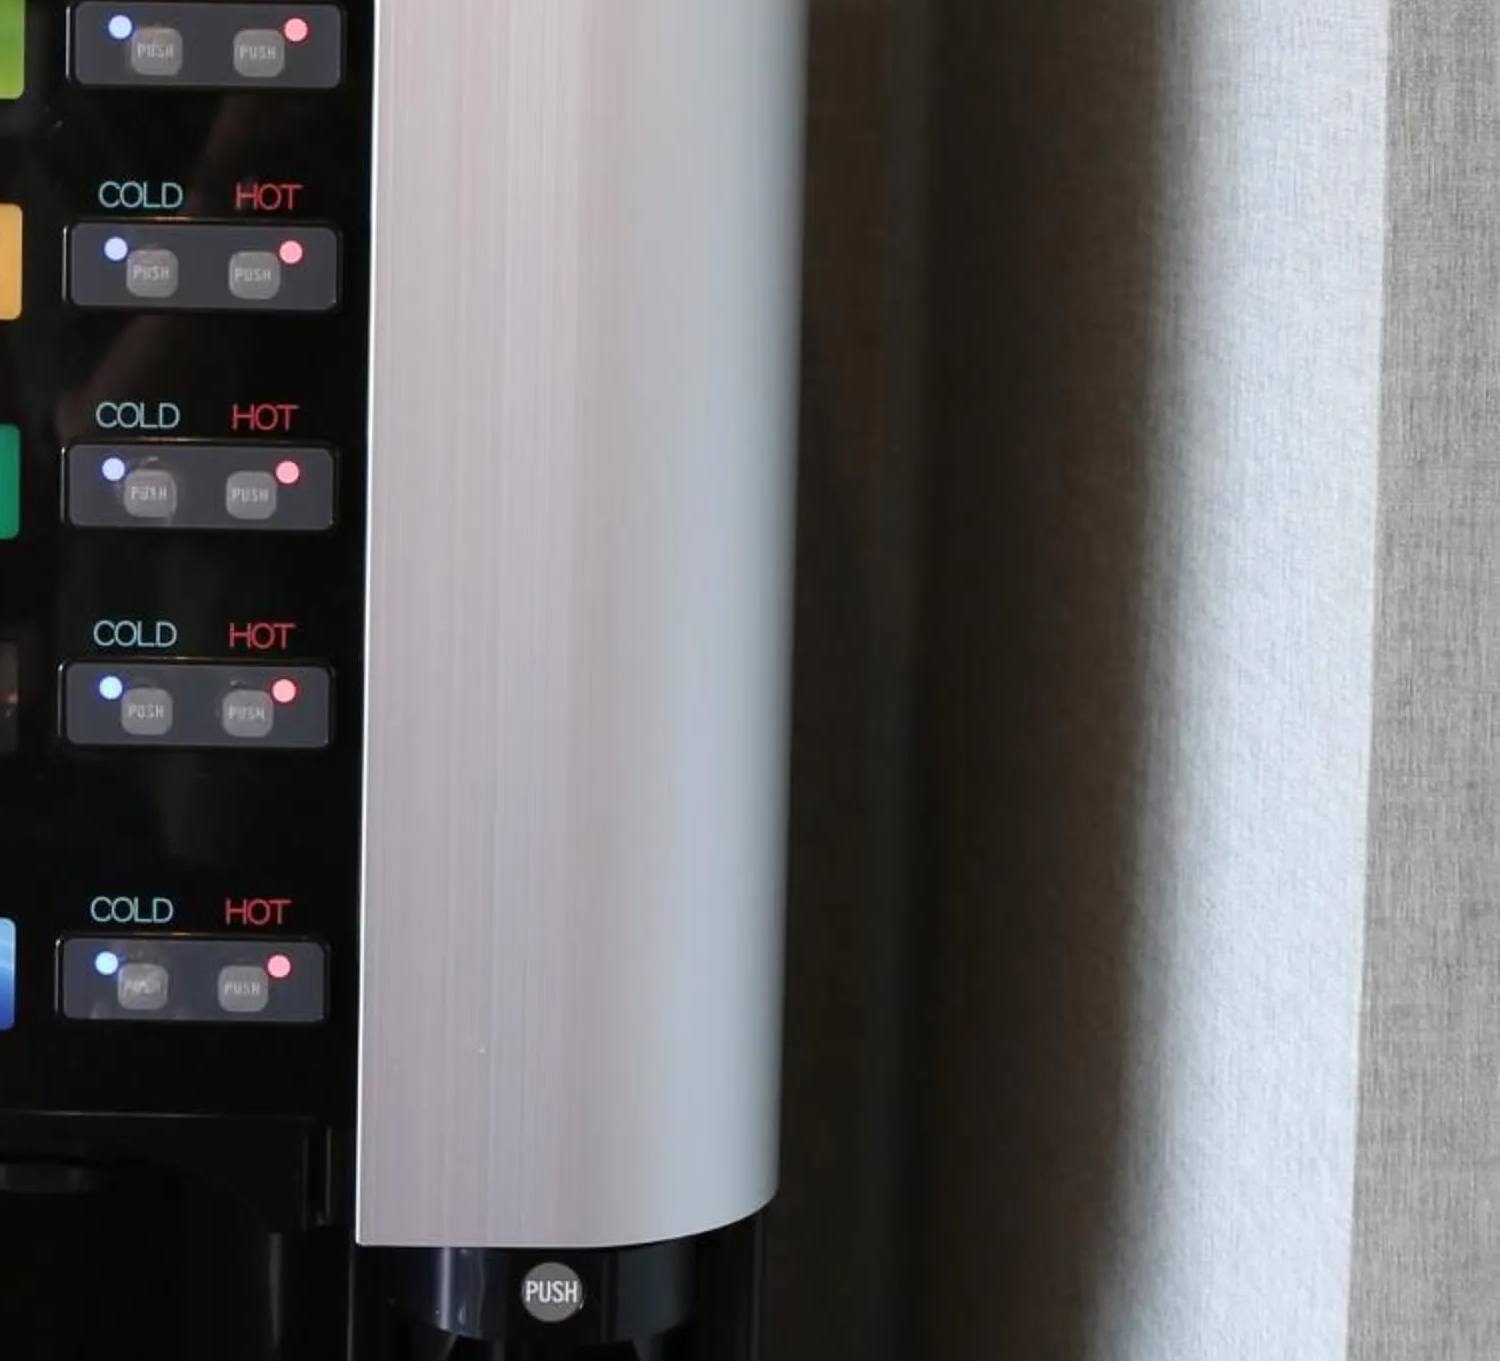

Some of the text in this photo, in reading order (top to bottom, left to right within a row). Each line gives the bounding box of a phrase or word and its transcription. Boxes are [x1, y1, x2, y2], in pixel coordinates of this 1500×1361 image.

[137, 44, 174, 58] PUSH
[238, 45, 277, 59] PUSH
[98, 181, 304, 210] COLD HOT
[132, 265, 170, 279] PUSH
[234, 268, 271, 281] PUSH
[96, 401, 299, 430] COLD HOT
[130, 486, 167, 500] PUSH
[232, 488, 269, 502] PUSH
[93, 620, 296, 649] COLD HOT
[127, 704, 164, 718] PUSH
[228, 705, 265, 720] PUSH
[90, 896, 292, 925] COLD HOT
[224, 982, 261, 996] PUSH
[525, 1280, 579, 1305] PUSH
